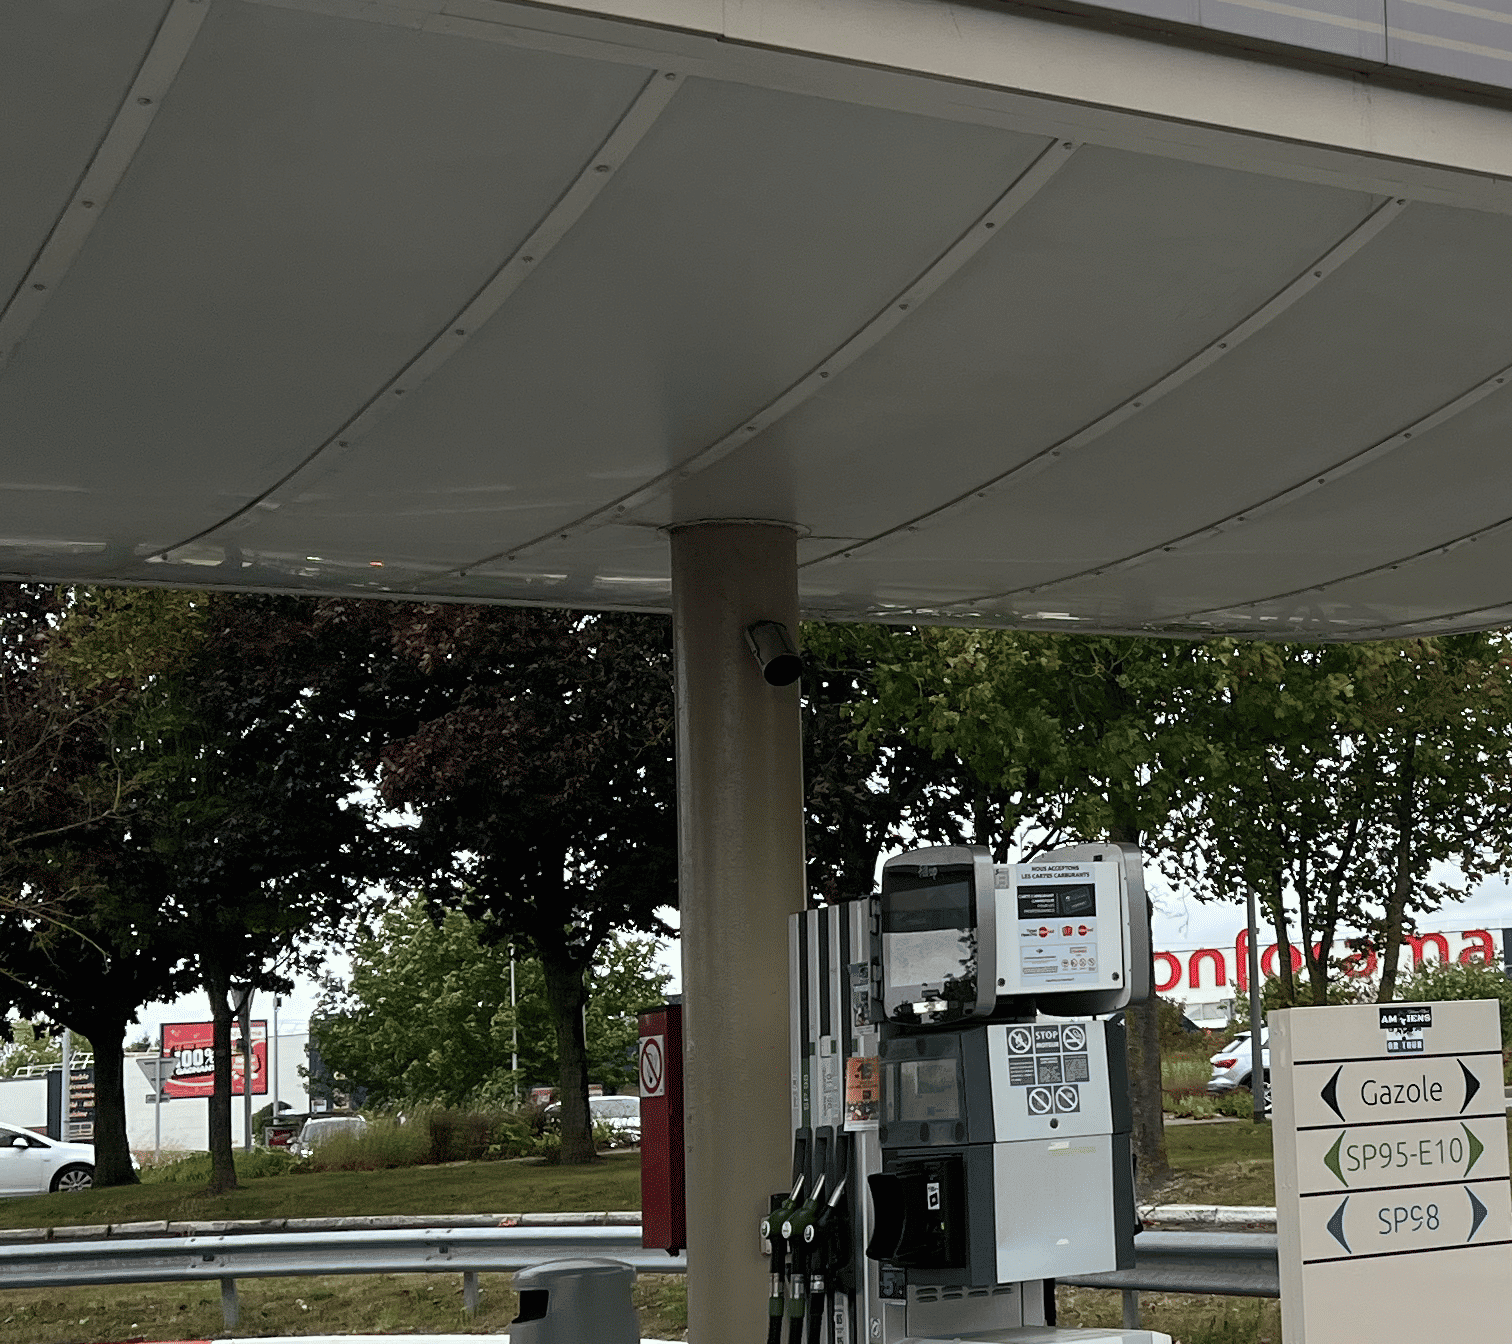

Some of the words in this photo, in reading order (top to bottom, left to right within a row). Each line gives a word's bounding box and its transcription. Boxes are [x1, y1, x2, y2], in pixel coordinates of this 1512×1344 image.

[1035, 1030, 1058, 1040] STOP
[1361, 1074, 1443, 1106] Gazole
[1346, 1137, 1463, 1172] SP95-E10
[1378, 1203, 1440, 1235] SP98
